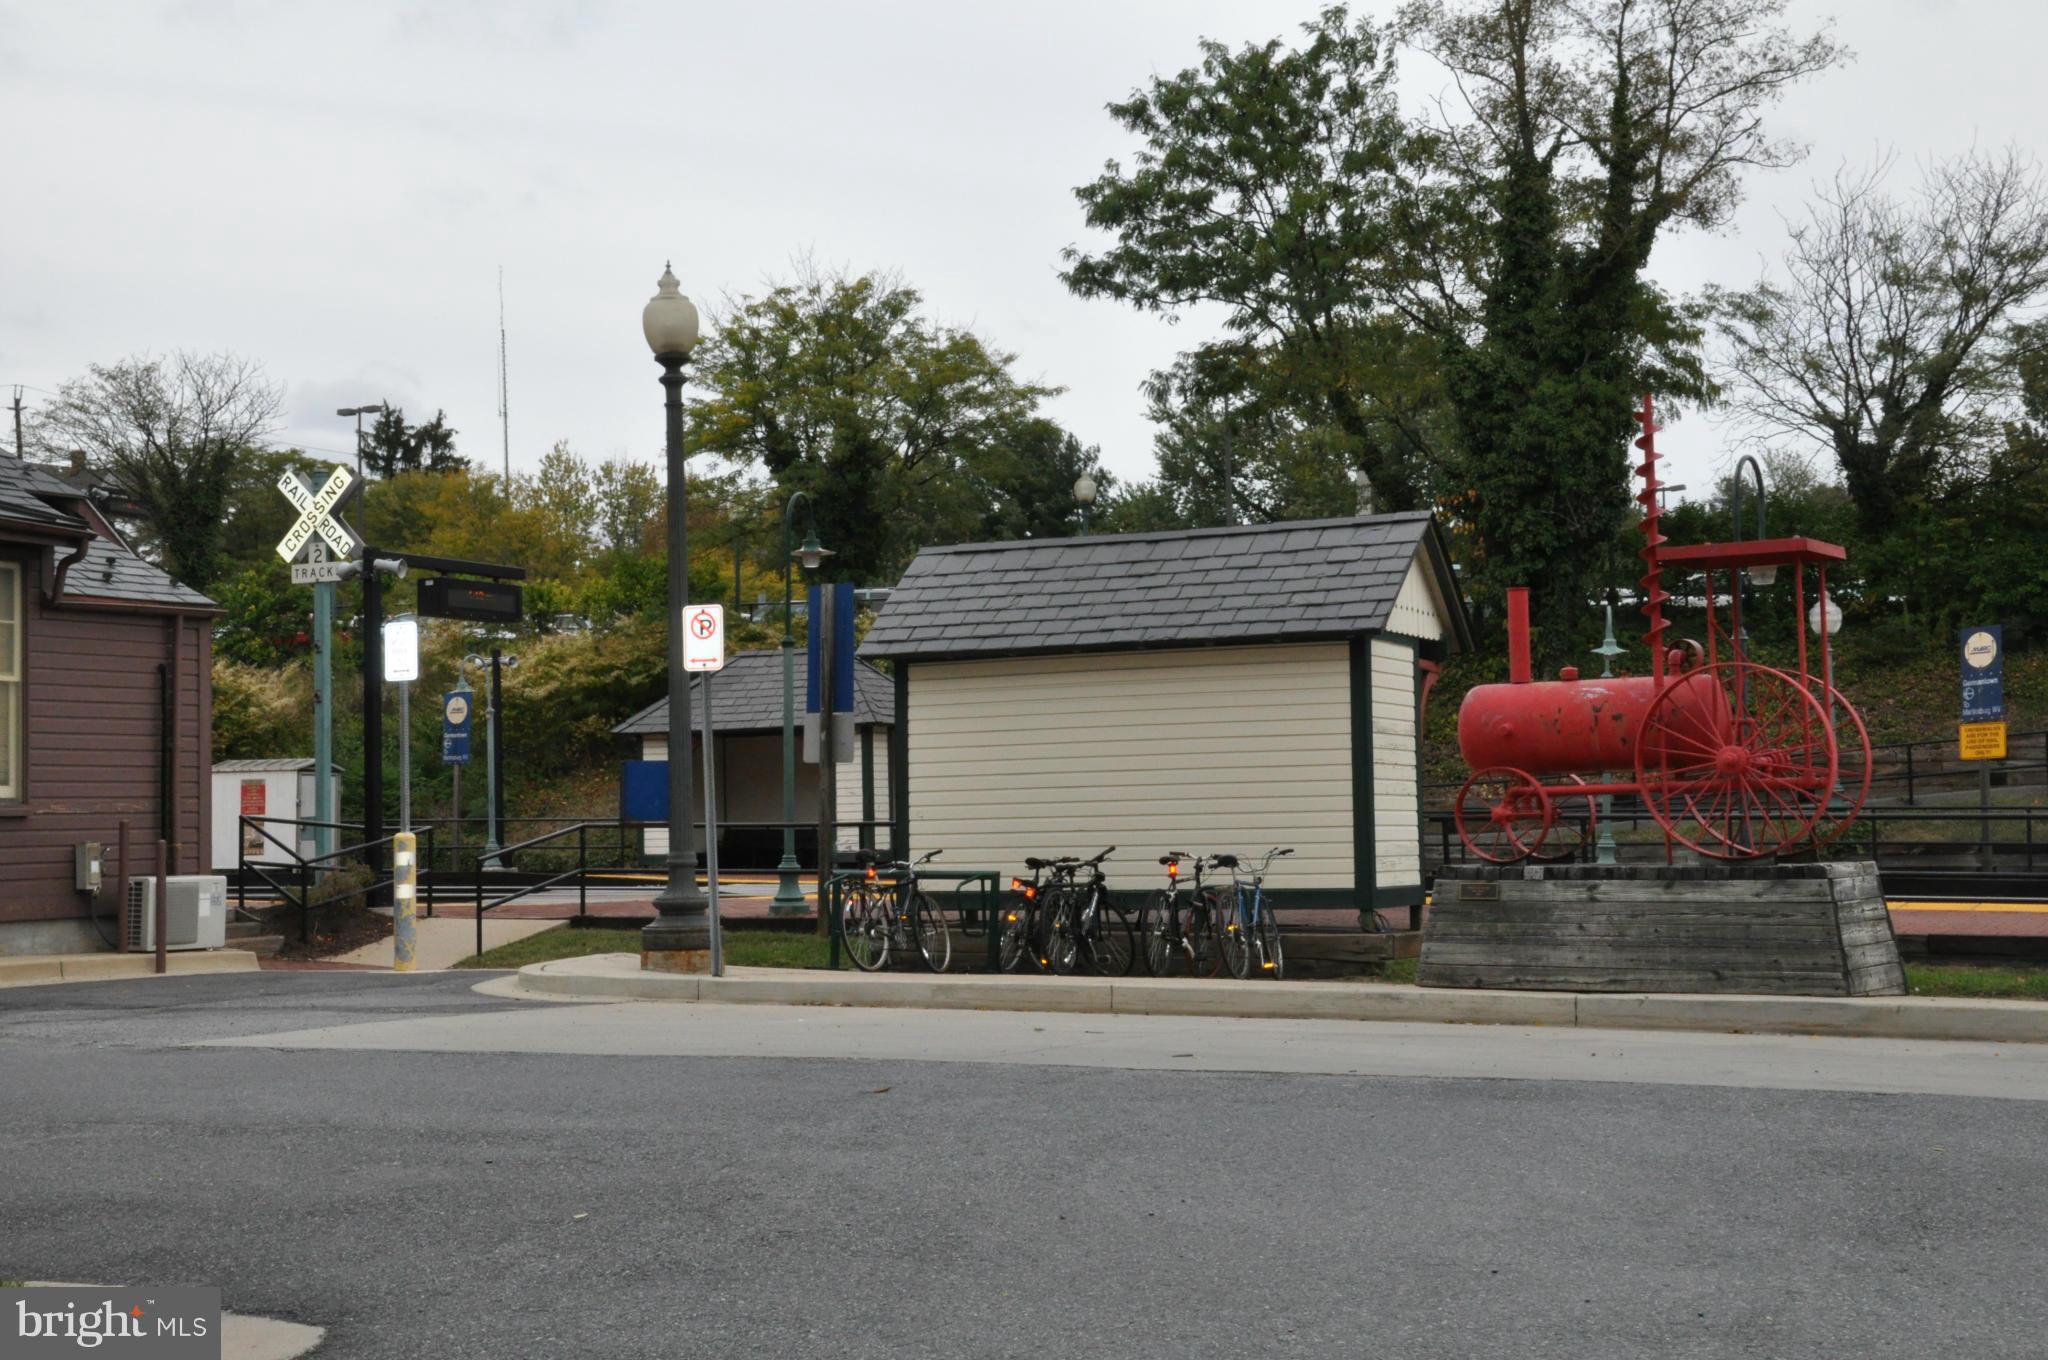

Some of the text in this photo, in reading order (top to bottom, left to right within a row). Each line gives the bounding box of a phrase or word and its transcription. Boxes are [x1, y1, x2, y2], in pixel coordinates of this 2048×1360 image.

[281, 476, 351, 555] RAIL ROAD
[284, 476, 345, 552] CROSSING
[294, 566, 334, 579] TRACK
[313, 548, 322, 563] 2
